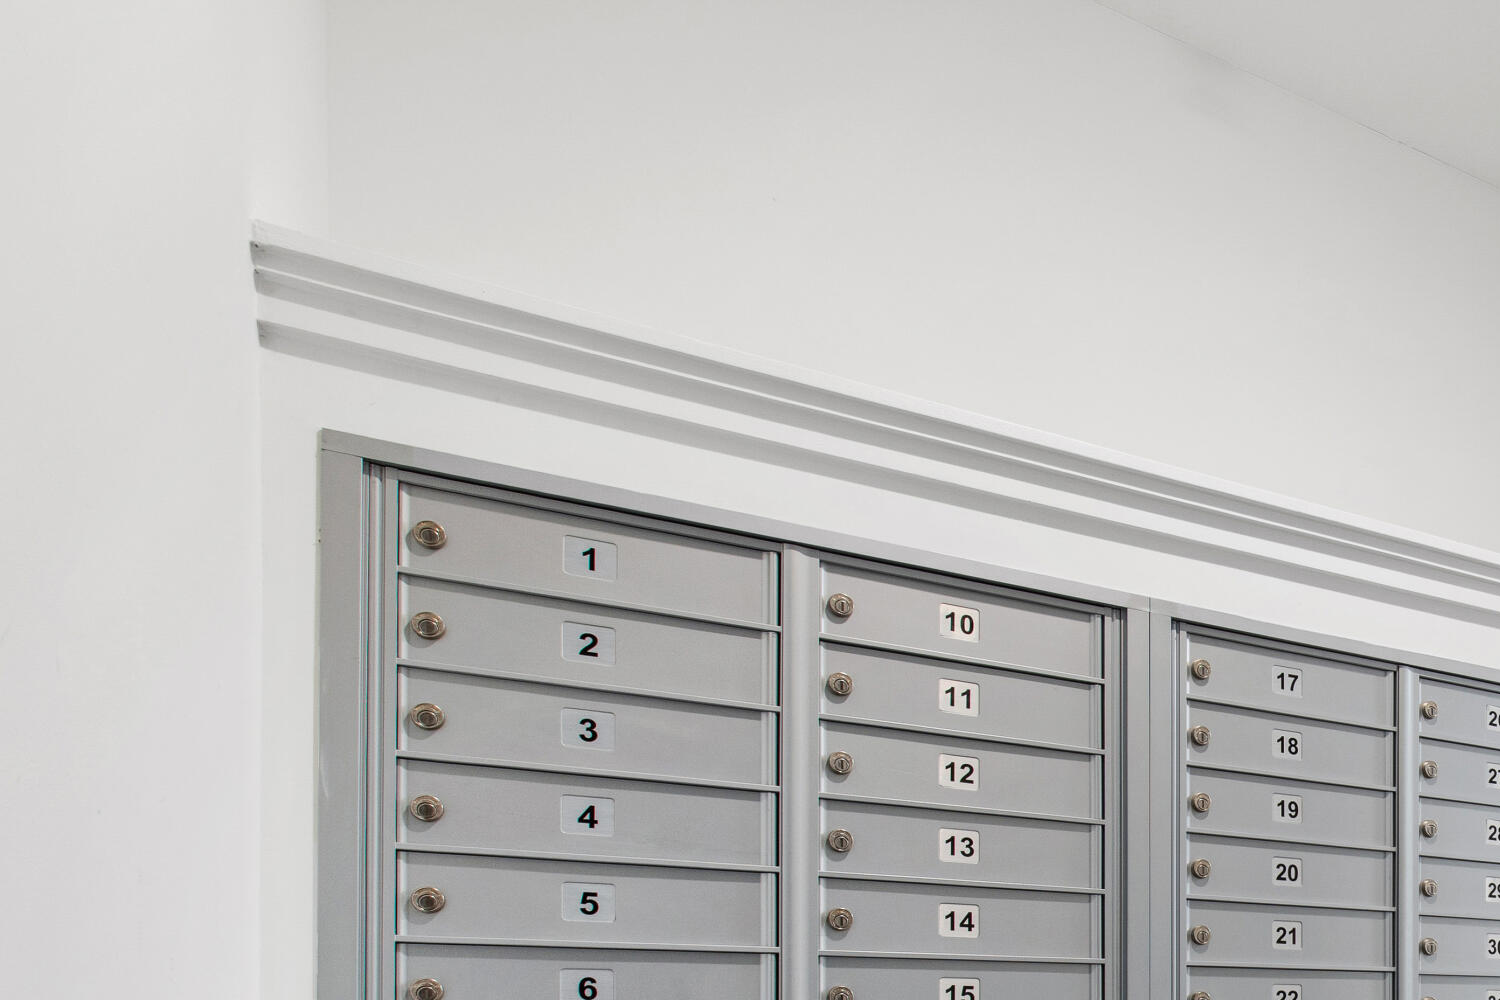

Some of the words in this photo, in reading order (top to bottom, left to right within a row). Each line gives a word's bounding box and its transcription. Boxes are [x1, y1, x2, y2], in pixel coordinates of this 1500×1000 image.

[582, 547, 596, 572] 1
[945, 611, 974, 635] 10
[578, 632, 599, 658] 2
[1276, 672, 1299, 692] 17
[945, 686, 971, 709] 11
[578, 718, 598, 743] 3
[1276, 735, 1299, 756] 18
[945, 761, 974, 785] 12
[577, 805, 599, 829] 4
[1277, 799, 1299, 819] 19
[945, 835, 975, 858] 13
[1275, 863, 1299, 882] 20
[579, 891, 599, 916] 5
[945, 910, 975, 932] 14
[1276, 926, 1297, 945] 21
[578, 976, 598, 1000] 6
